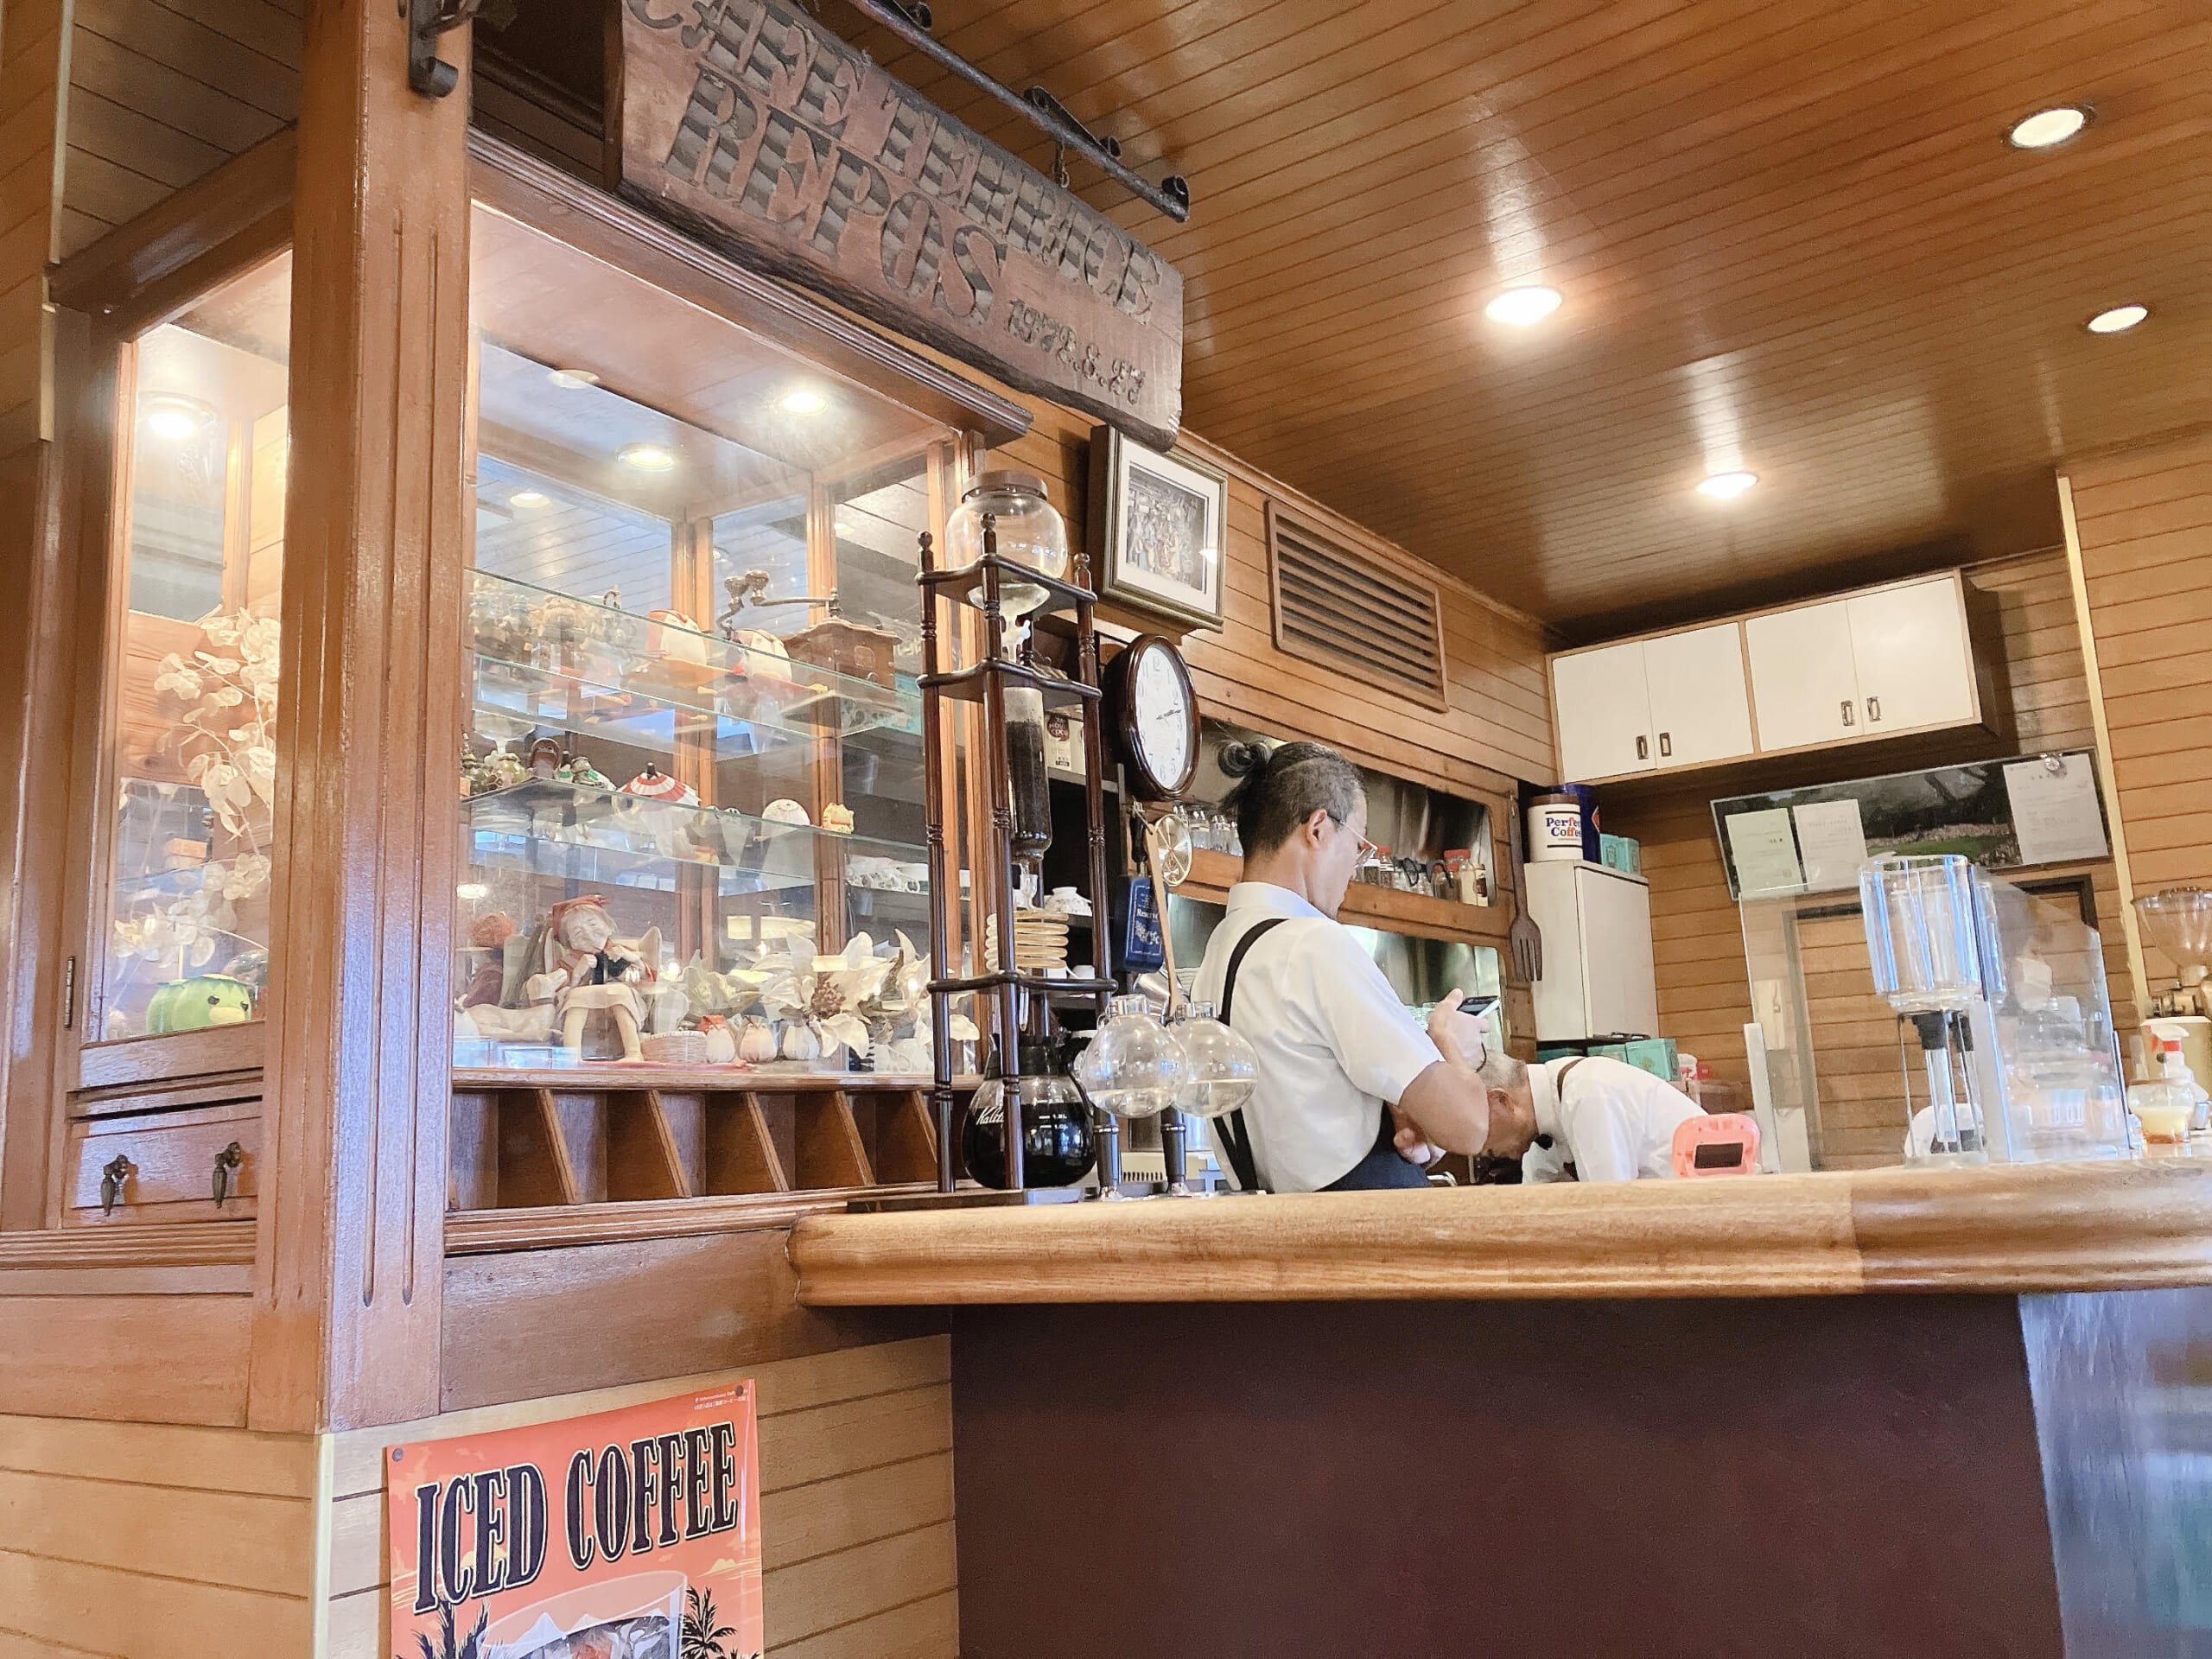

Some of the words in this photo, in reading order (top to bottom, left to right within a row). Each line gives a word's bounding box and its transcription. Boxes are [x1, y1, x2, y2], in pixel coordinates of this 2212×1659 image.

[659, 63, 1008, 327] REPOS
[976, 1106, 1004, 1125] Kalit
[414, 1462, 547, 1615] ICED
[566, 1421, 738, 1571] COFFEE
